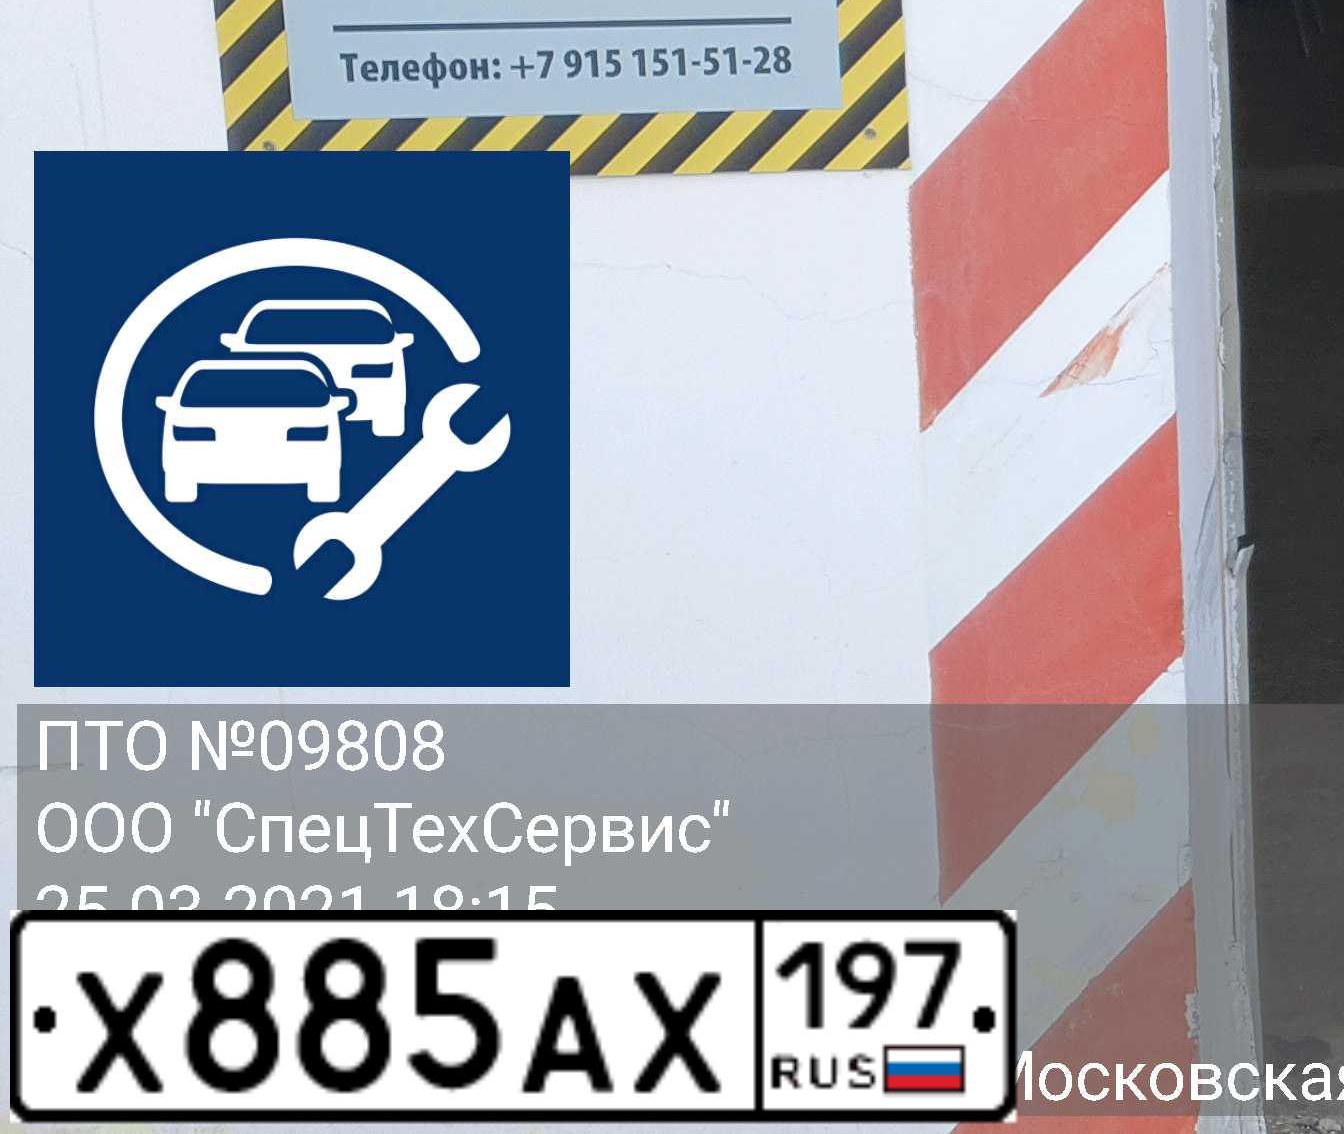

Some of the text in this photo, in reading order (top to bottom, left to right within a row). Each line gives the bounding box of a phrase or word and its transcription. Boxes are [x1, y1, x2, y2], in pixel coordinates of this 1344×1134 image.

[339, 45, 792, 90] Телефон: +7 915 151-51-28
